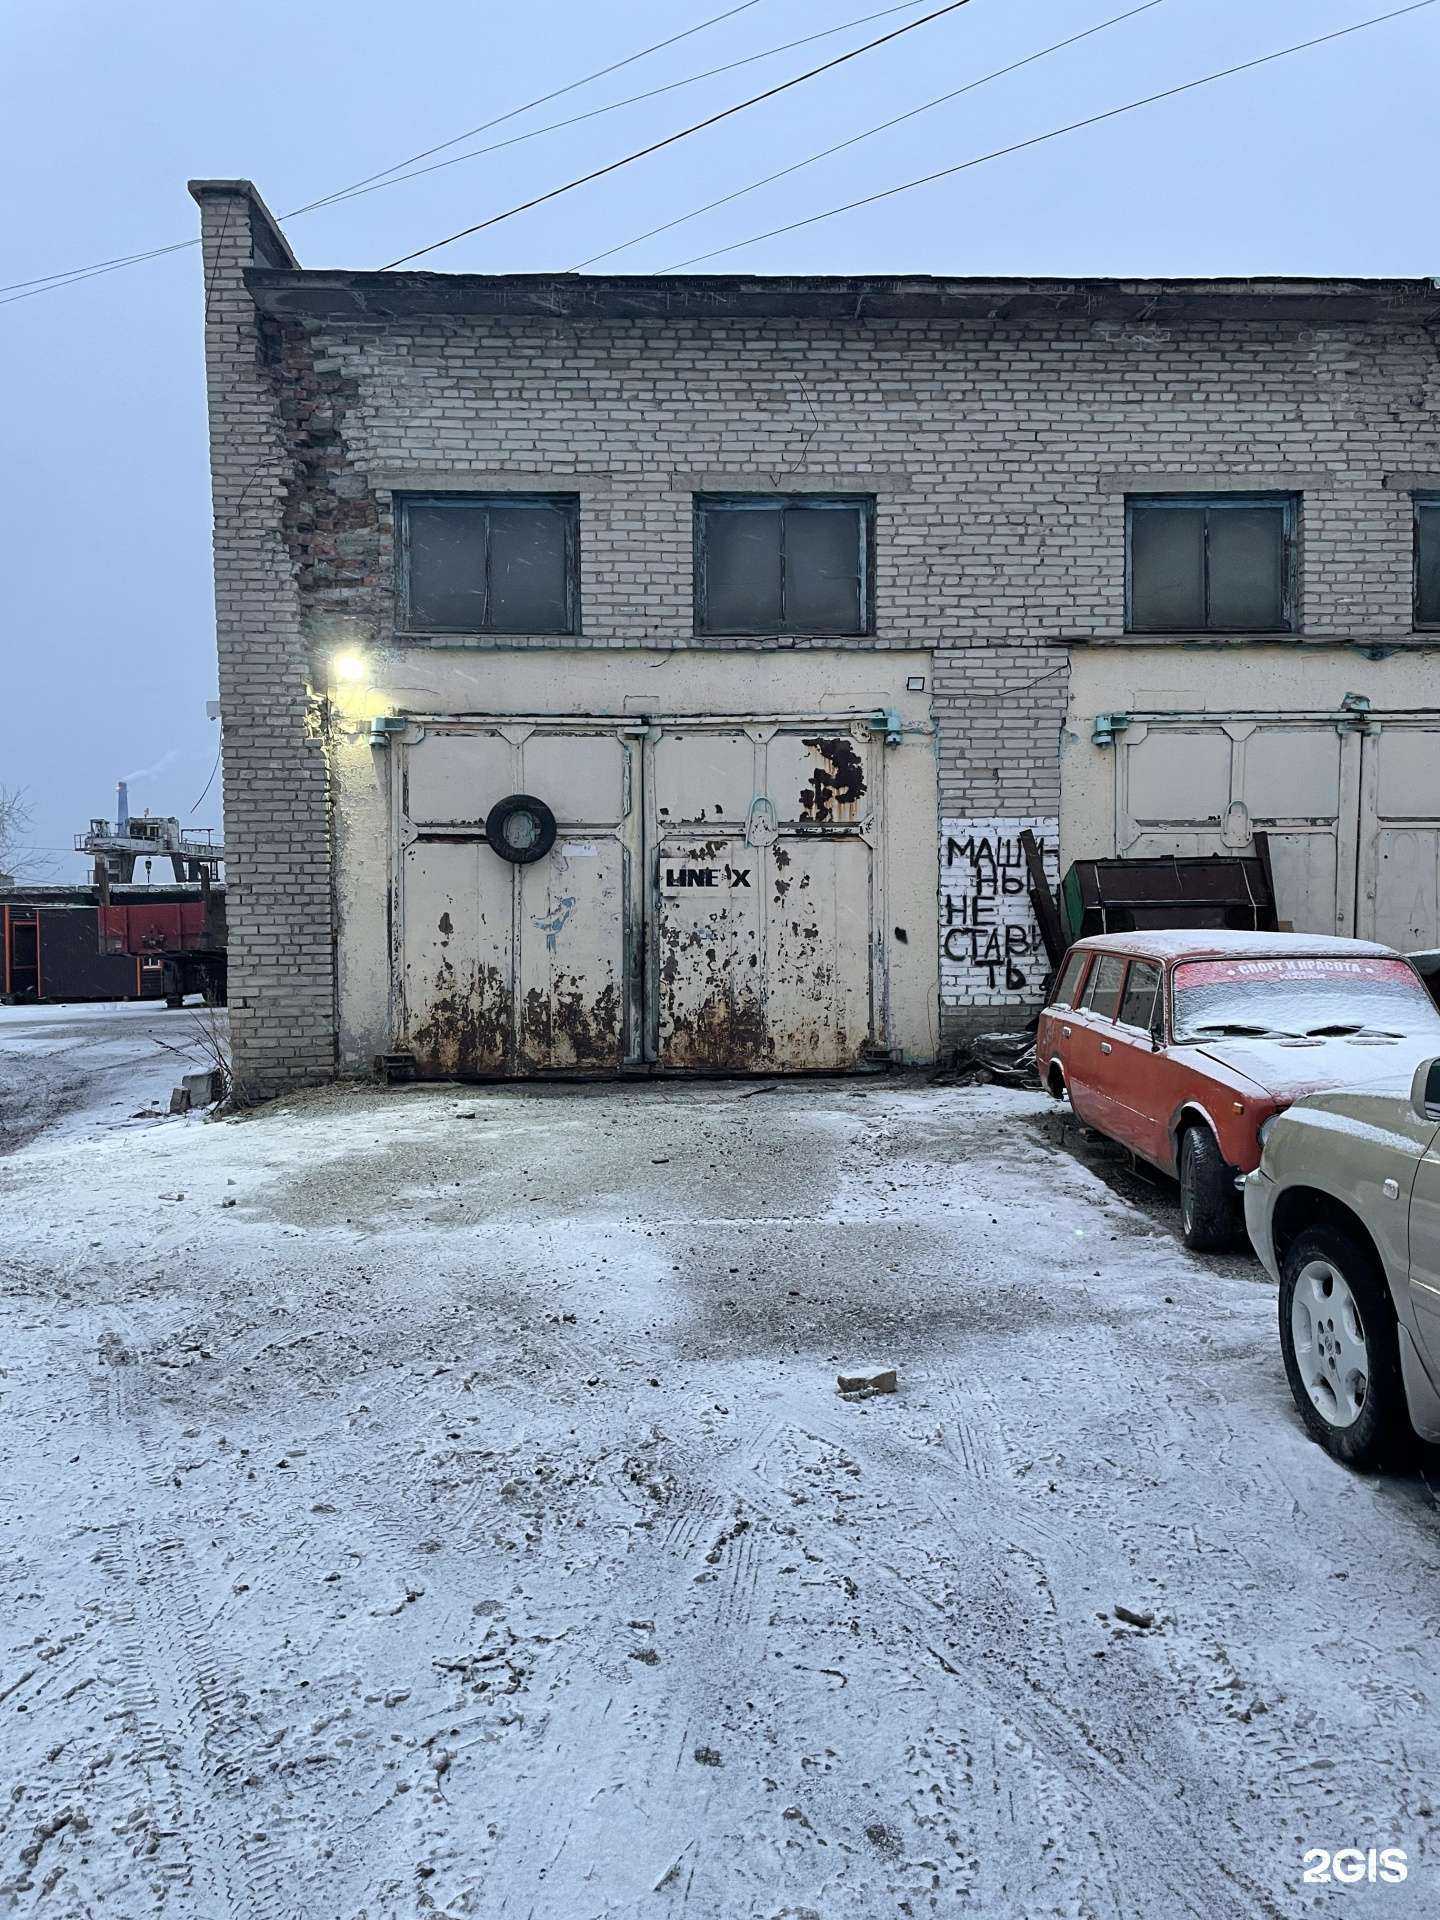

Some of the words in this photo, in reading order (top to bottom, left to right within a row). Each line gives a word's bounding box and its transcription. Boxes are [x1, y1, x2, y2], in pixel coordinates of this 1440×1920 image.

[976, 862, 1031, 895] НЫ
[946, 895, 995, 926] НЕ
[975, 958, 1026, 990] ТЬ
[1238, 962, 1282, 974] СПОРТ
